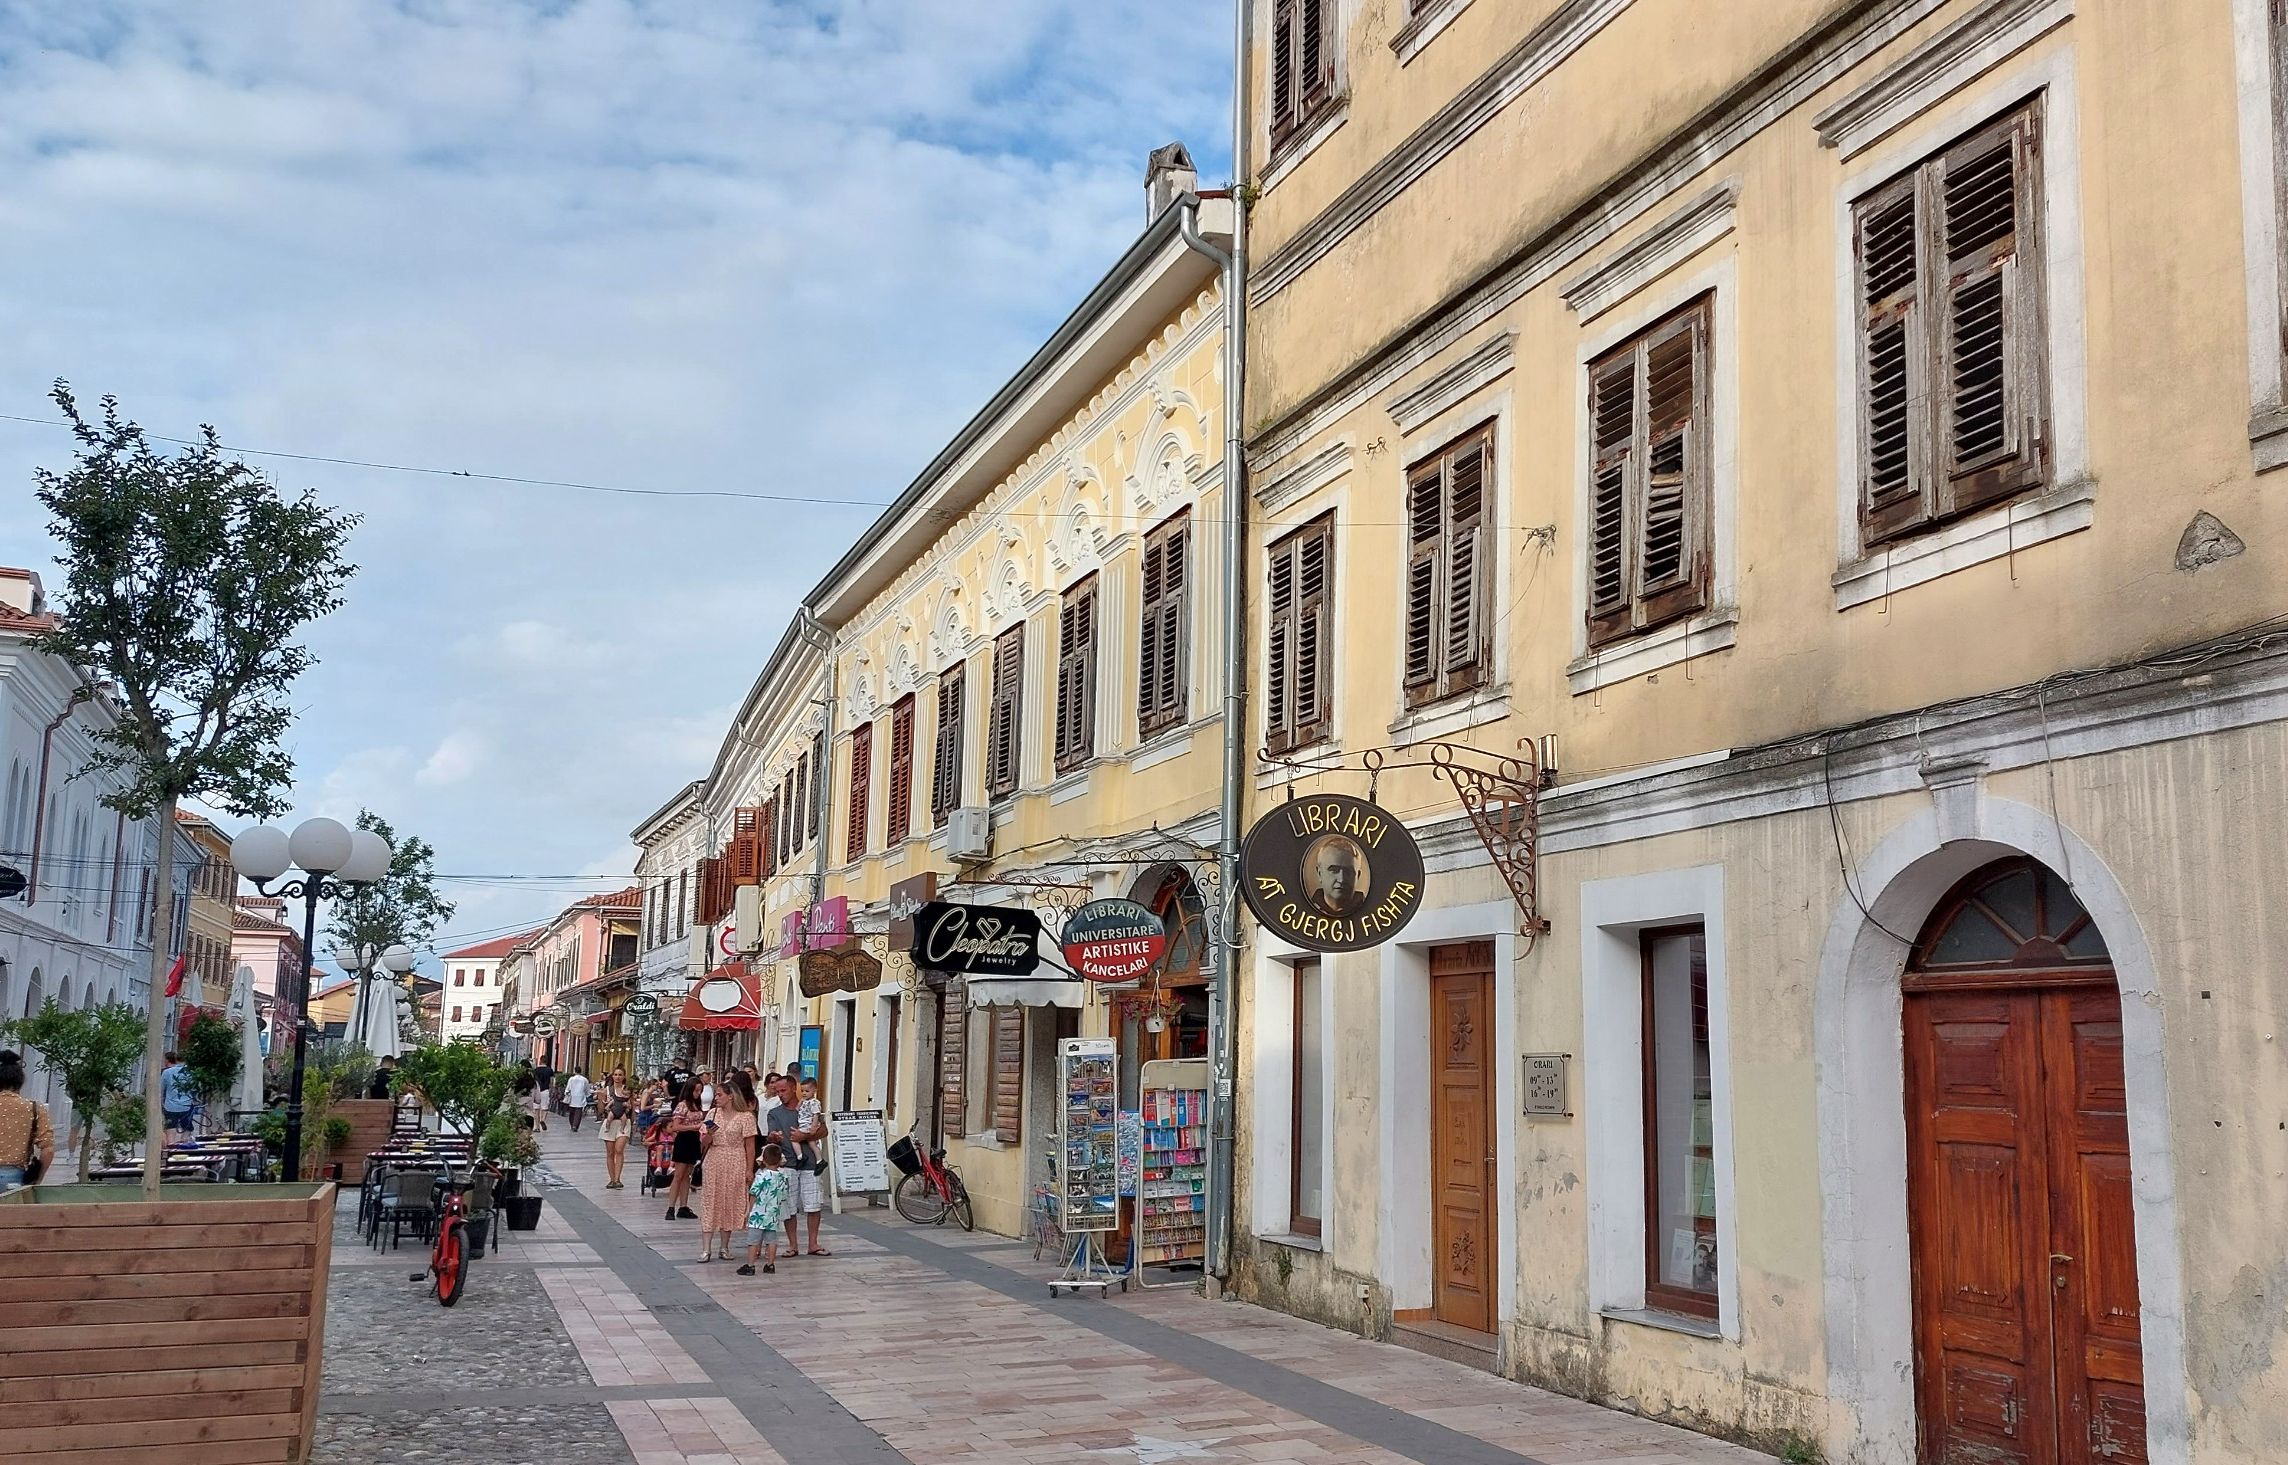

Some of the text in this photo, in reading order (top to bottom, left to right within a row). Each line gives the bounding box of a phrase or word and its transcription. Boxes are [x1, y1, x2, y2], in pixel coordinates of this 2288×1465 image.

[1286, 803, 1388, 849] LIBRARI
[1084, 904, 1140, 922] LIBRARI
[1255, 877, 1416, 943] AT GJERGJ FISHTA
[927, 906, 1032, 969] Cleopatra
[1071, 924, 1155, 943] UNIVERSITARE
[1082, 940, 1150, 960] ARTISTIKE
[981, 955, 1017, 966] Jewelry
[1082, 956, 1149, 977] KANCELARI
